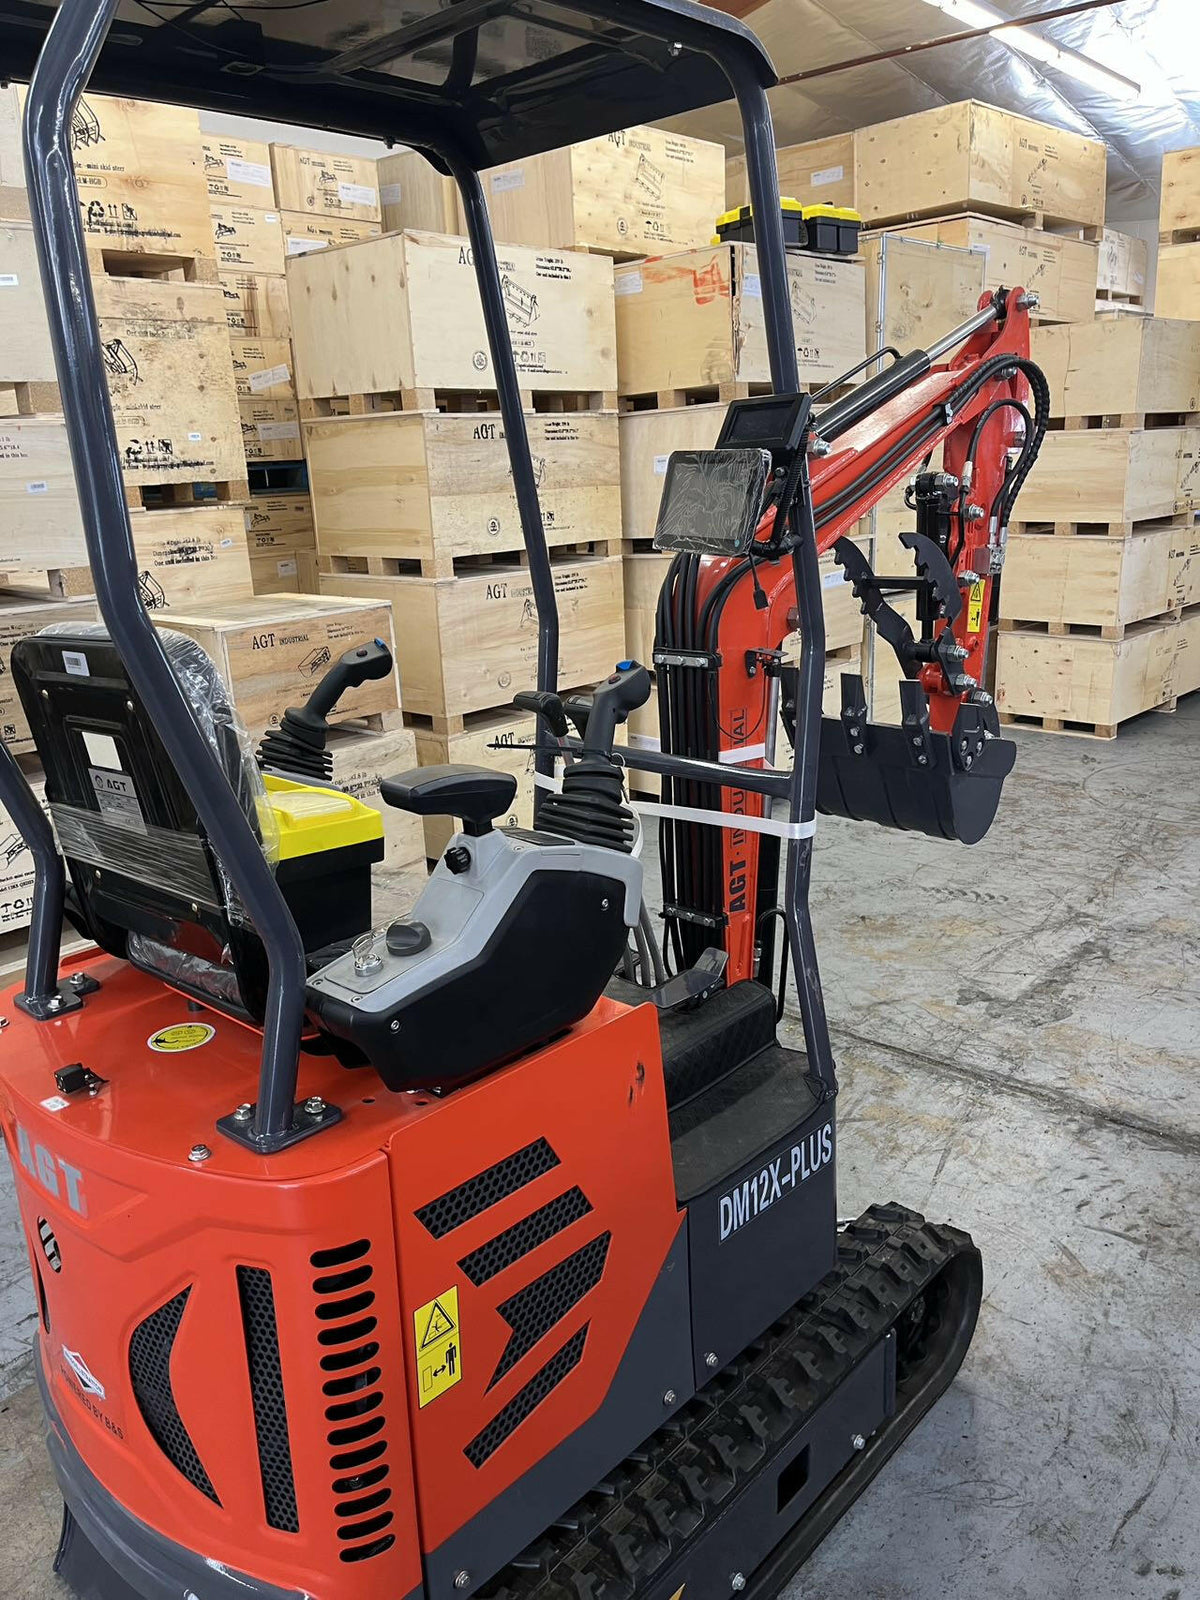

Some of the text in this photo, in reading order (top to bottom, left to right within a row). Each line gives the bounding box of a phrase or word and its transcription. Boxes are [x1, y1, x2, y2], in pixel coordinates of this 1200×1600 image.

[473, 423, 496, 440] AGT
[486, 582, 508, 600] AGT
[252, 633, 310, 650] AGT INDUSTRIAL
[106, 778, 127, 792] AGT
[729, 860, 747, 914] AGT
[16, 1122, 88, 1218] AGT
[719, 1123, 832, 1242] DM12X-PLUS
